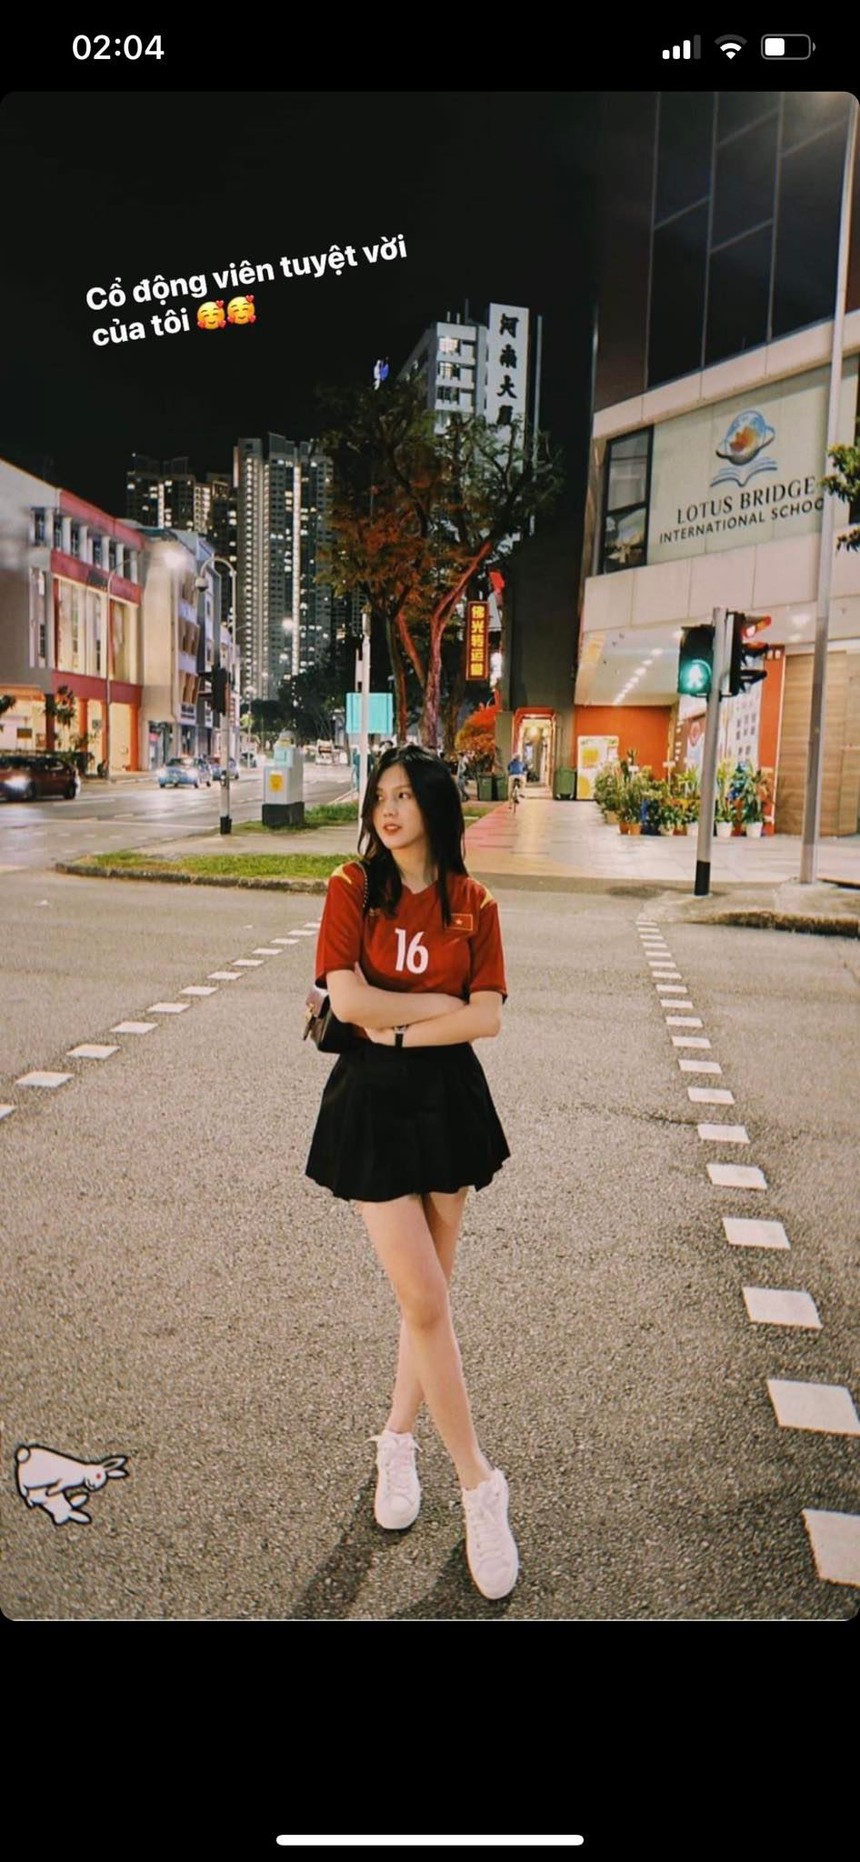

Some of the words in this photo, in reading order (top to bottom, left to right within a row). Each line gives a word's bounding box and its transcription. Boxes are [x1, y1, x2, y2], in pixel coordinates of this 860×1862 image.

[660, 511, 765, 544] INTERNATIONAL
[771, 497, 824, 520] SCHOO
[677, 495, 733, 525] LOTUS
[740, 475, 816, 510] BRIDGE
[394, 928, 429, 974] 16
